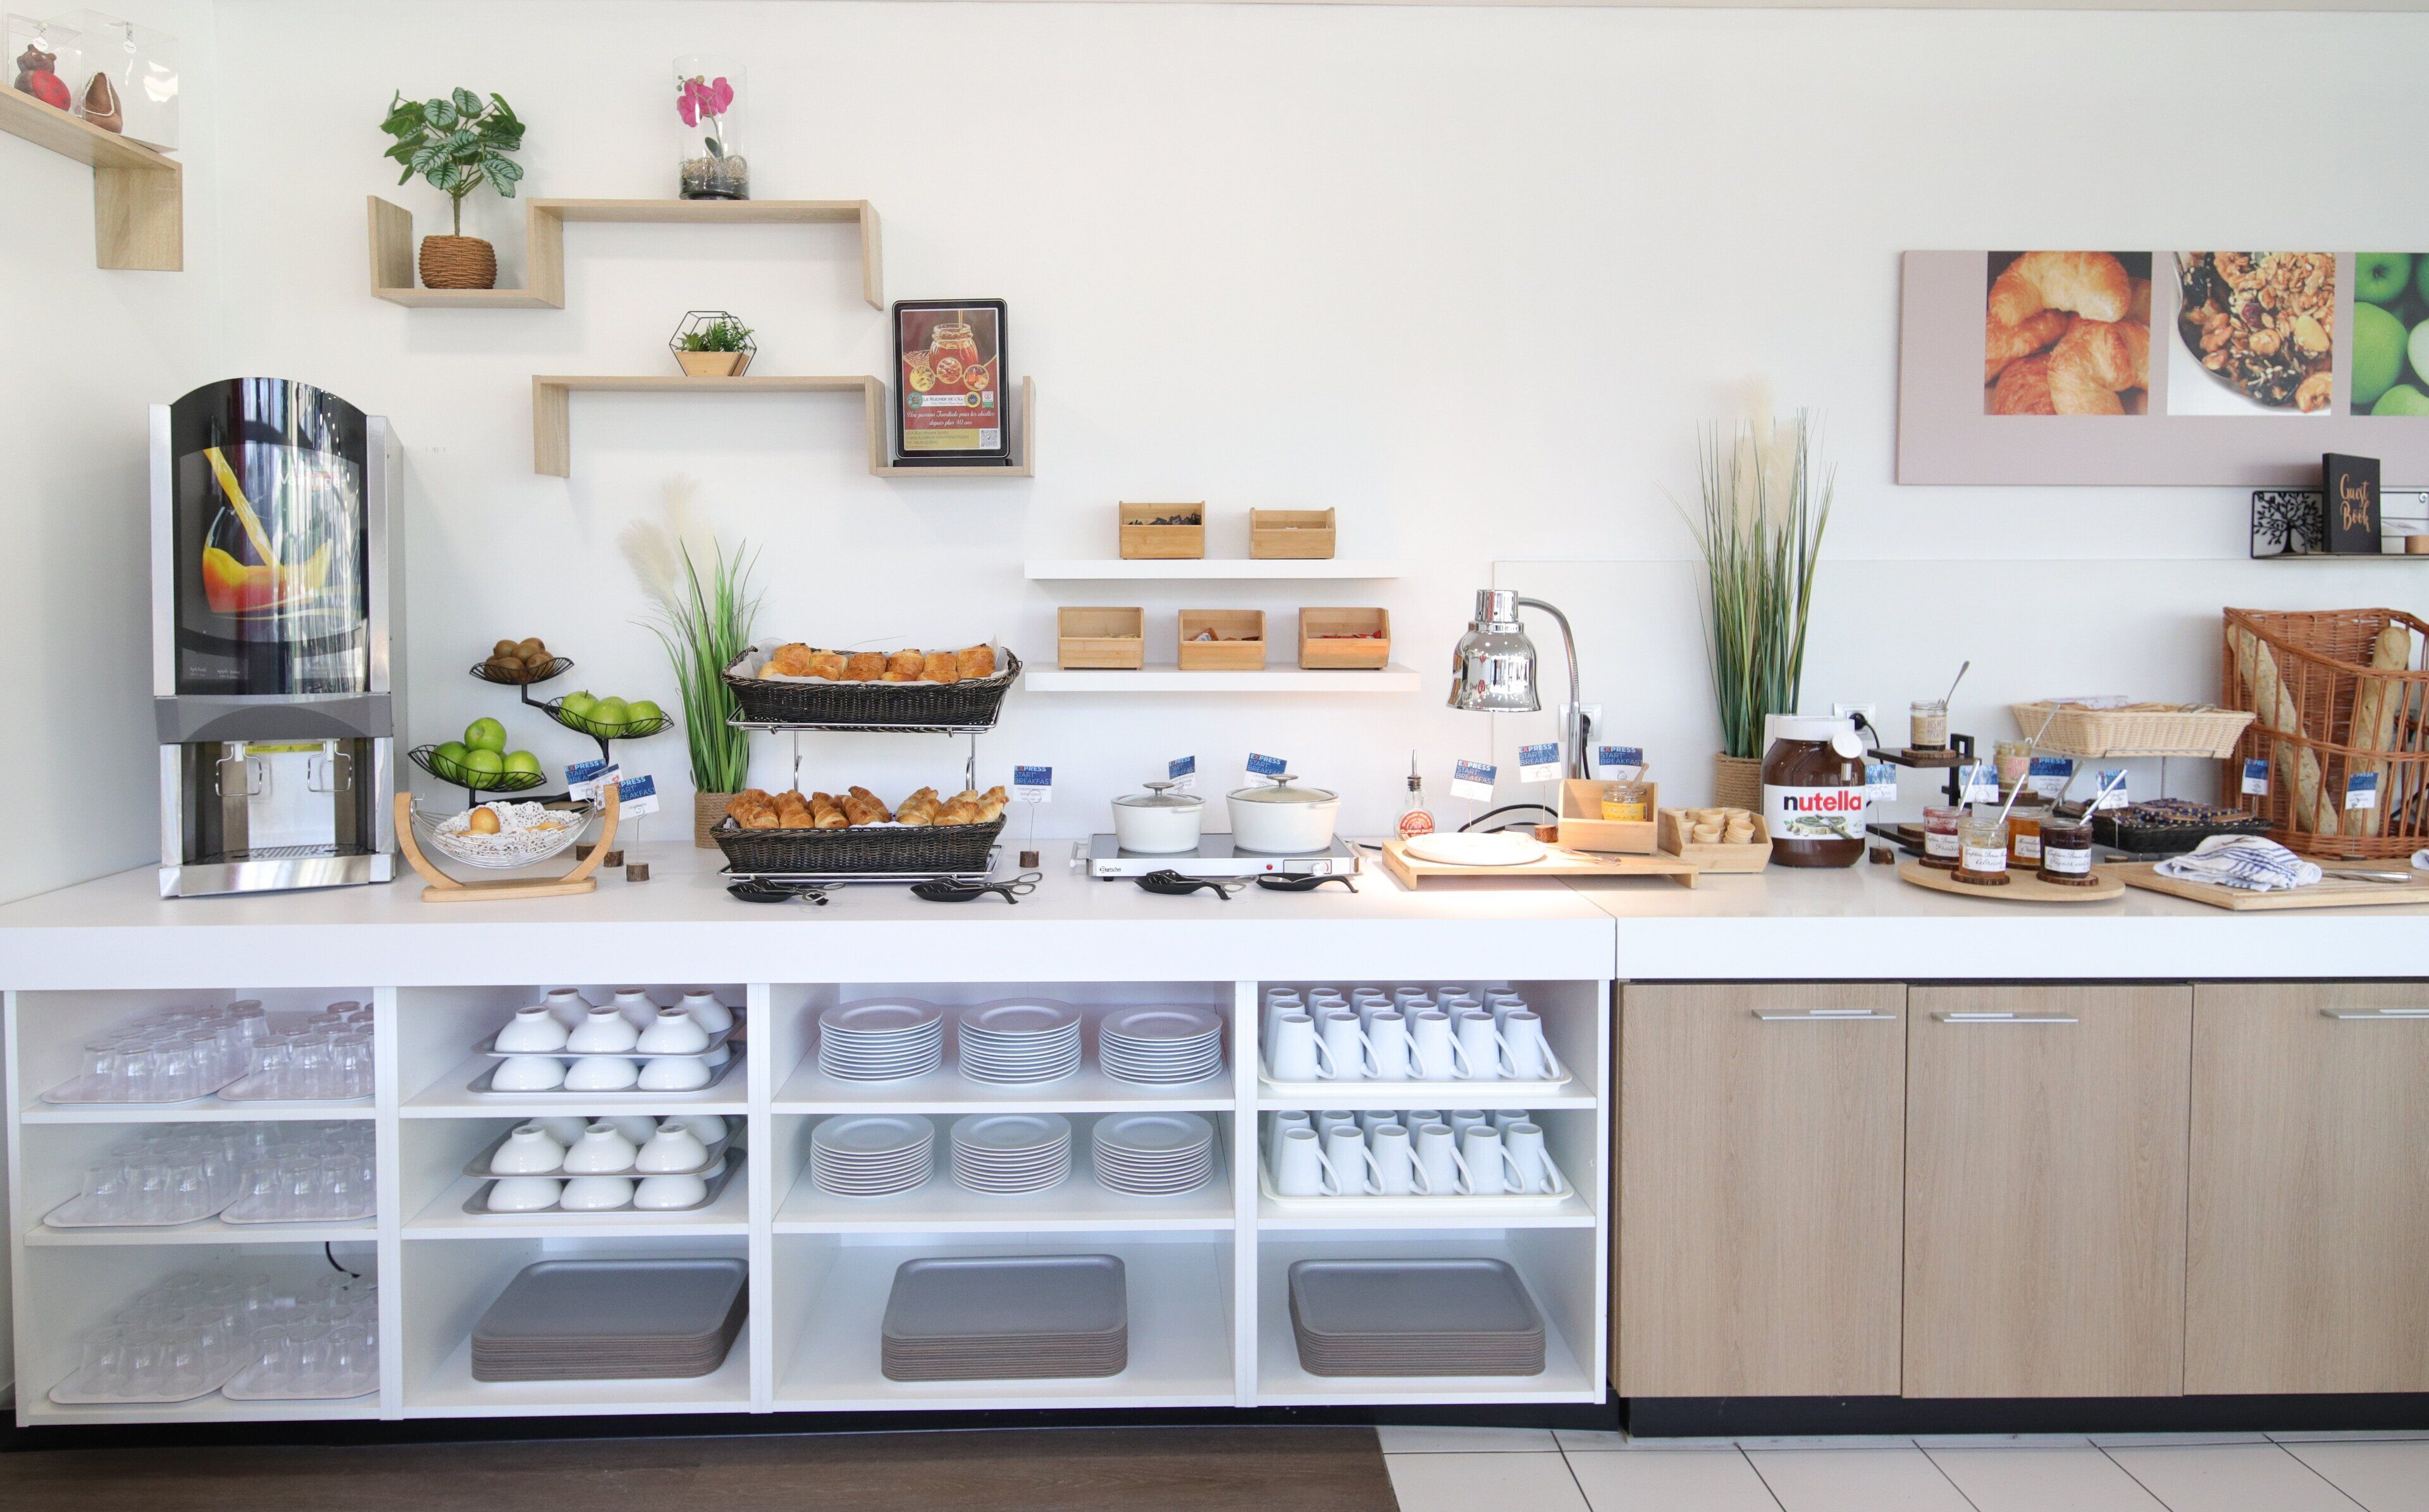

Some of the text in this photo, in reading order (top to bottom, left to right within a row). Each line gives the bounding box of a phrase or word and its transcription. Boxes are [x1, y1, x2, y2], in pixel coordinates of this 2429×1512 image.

[2340, 474, 2370, 507] Guest
[2340, 500, 2370, 532] Book
[1519, 744, 1552, 753] EXPRESS
[1250, 754, 1281, 765] EXPRESS
[565, 760, 600, 772] EXPRESS
[1458, 760, 1491, 771] EXPRESS
[617, 777, 646, 788] PRESS
[1456, 773, 1495, 784] BREAKFAST
[619, 785, 636, 794] ART
[620, 787, 655, 801] REAKFAST
[1784, 791, 1861, 811] nutella
